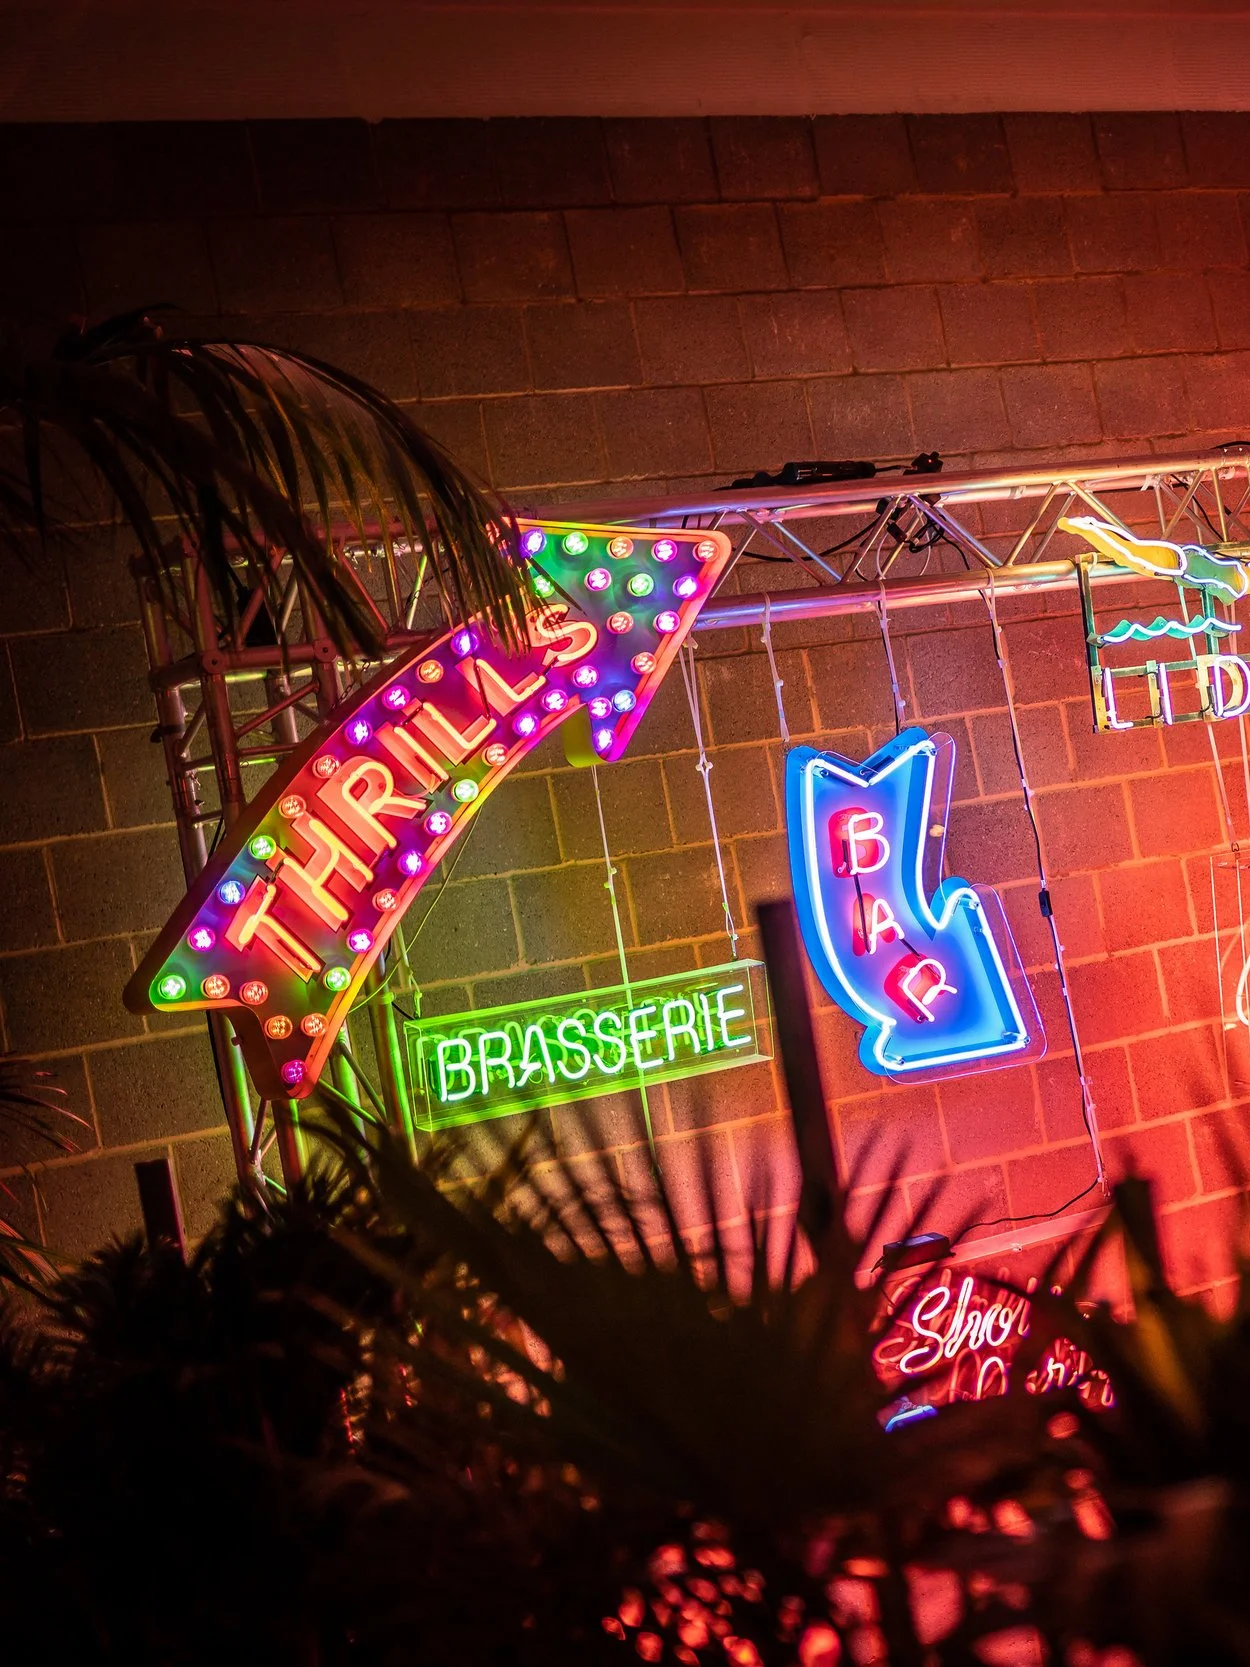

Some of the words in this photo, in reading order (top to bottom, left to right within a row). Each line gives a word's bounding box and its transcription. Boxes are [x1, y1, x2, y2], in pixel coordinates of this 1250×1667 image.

[227, 603, 598, 980] THRILLS
[838, 808, 957, 1023] BAR
[436, 983, 753, 1103] BRASSERIE
